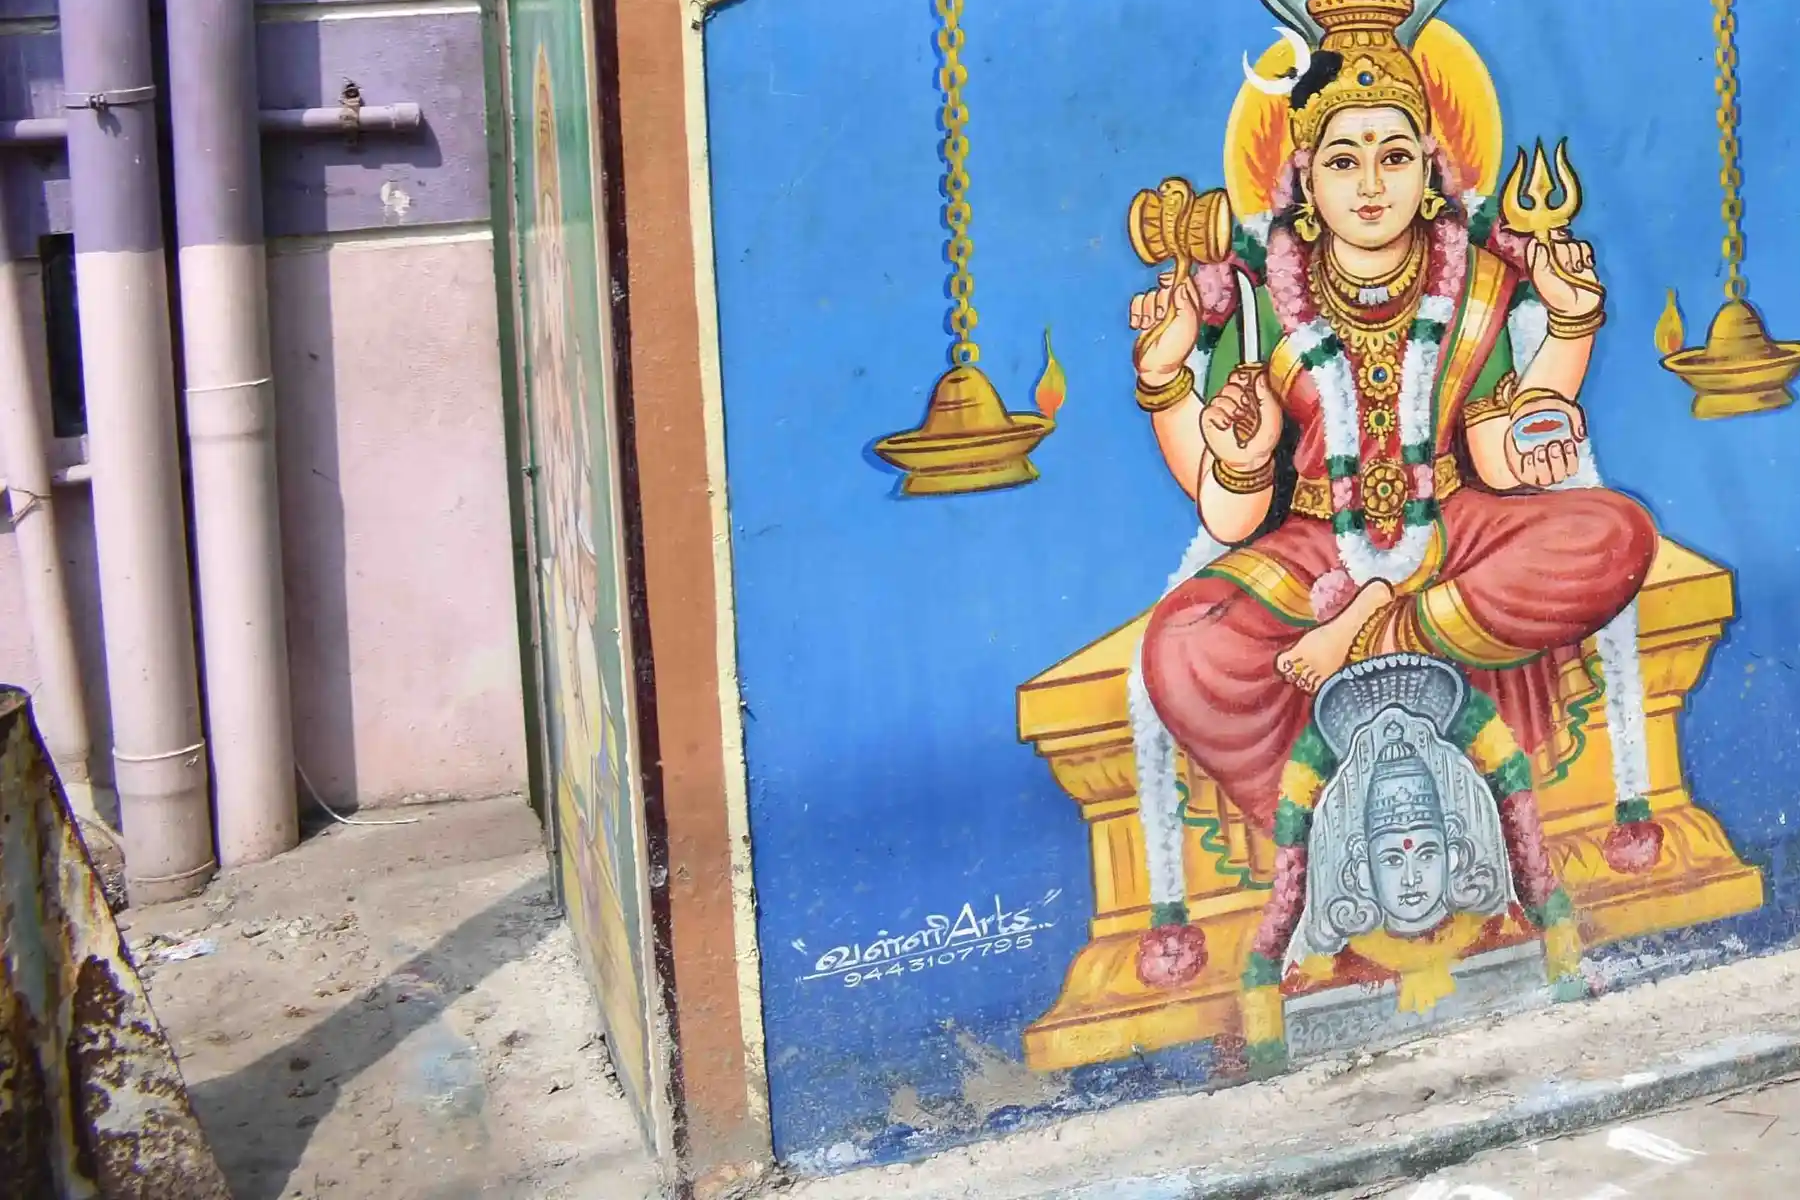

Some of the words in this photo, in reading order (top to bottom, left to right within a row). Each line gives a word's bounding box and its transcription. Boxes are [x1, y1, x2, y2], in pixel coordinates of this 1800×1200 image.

[814, 913, 950, 972] வள்ளி
[945, 894, 1032, 947] Arts
[843, 933, 1033, 988] 9443107795
